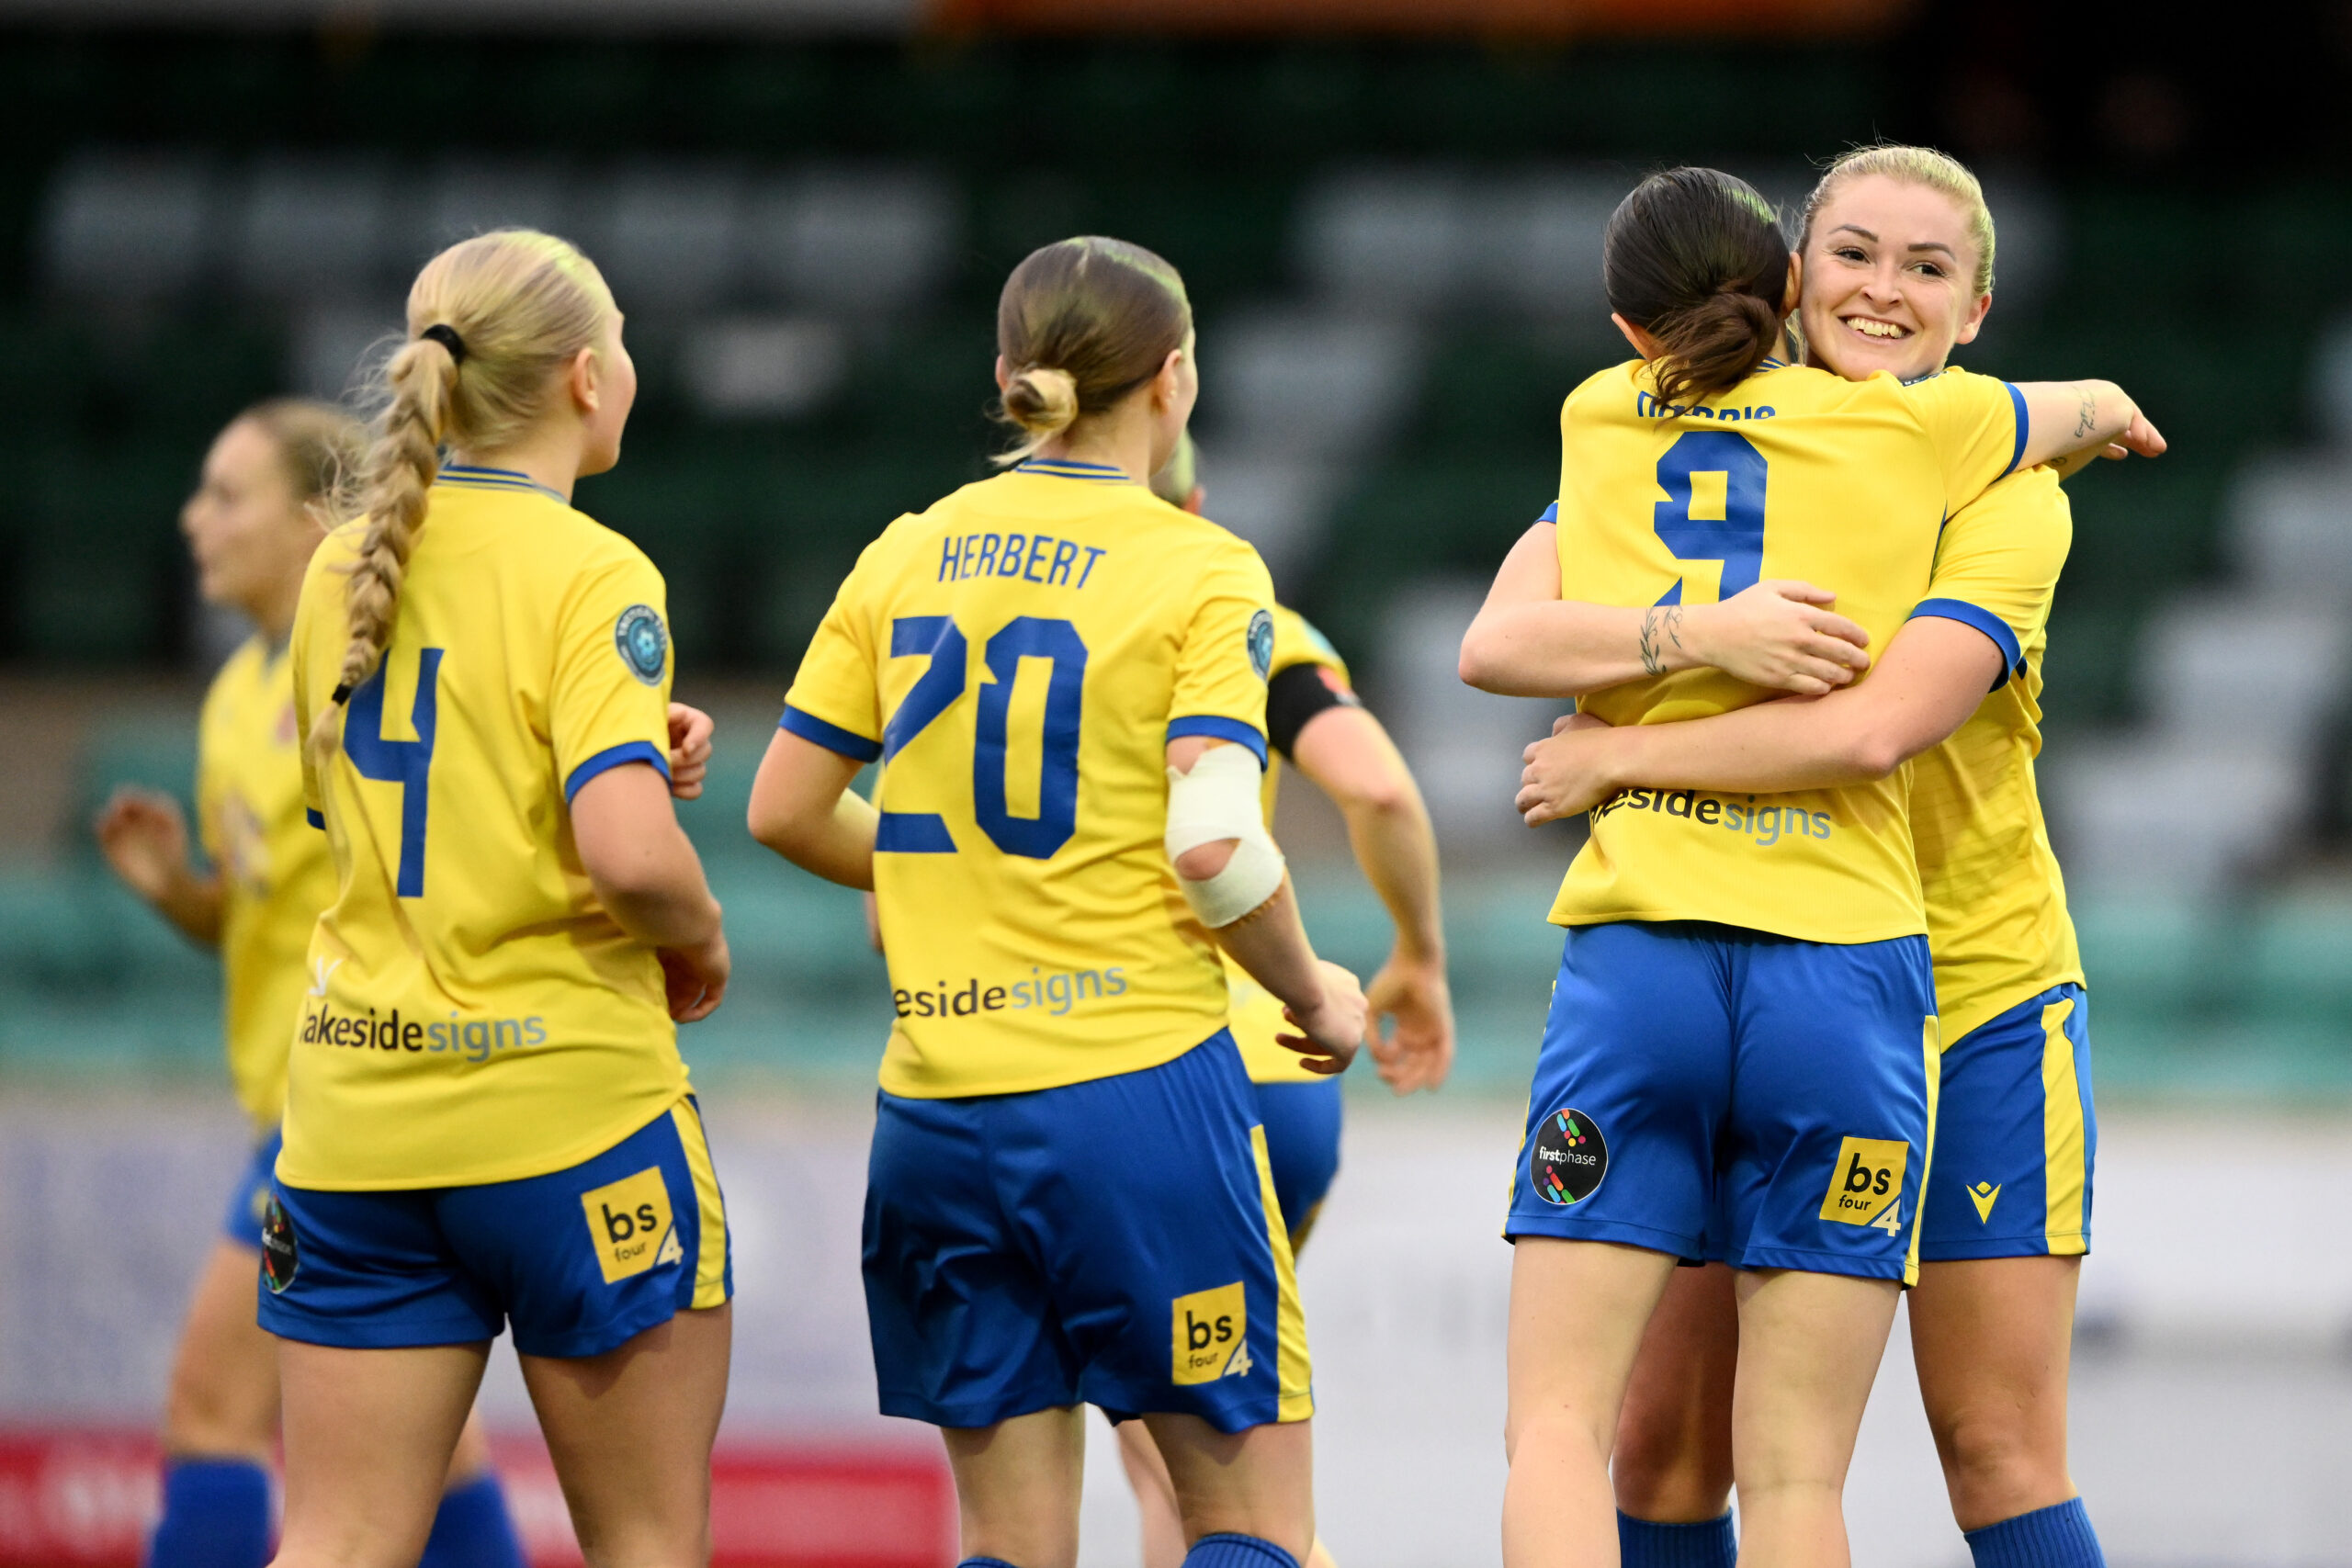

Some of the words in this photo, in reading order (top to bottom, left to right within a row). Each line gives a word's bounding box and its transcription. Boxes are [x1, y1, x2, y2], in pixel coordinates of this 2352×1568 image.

[1654, 431, 1769, 607] 9
[937, 534, 1106, 589] HERBERT
[874, 615, 1089, 861] 20
[343, 647, 446, 898] 4
[300, 1001, 548, 1064] lakesidesigns
[1539, 1145, 1597, 1166] firstphase
[1843, 1152, 1892, 1196] bs
[602, 1202, 658, 1245] bs
[1838, 1194, 1872, 1212] four
[1870, 1198, 1902, 1238] 4
[614, 1242, 647, 1263] four
[1186, 1310, 1233, 1351] bs
[1188, 1352, 1218, 1371] four
[1224, 1337, 1253, 1377] 4
